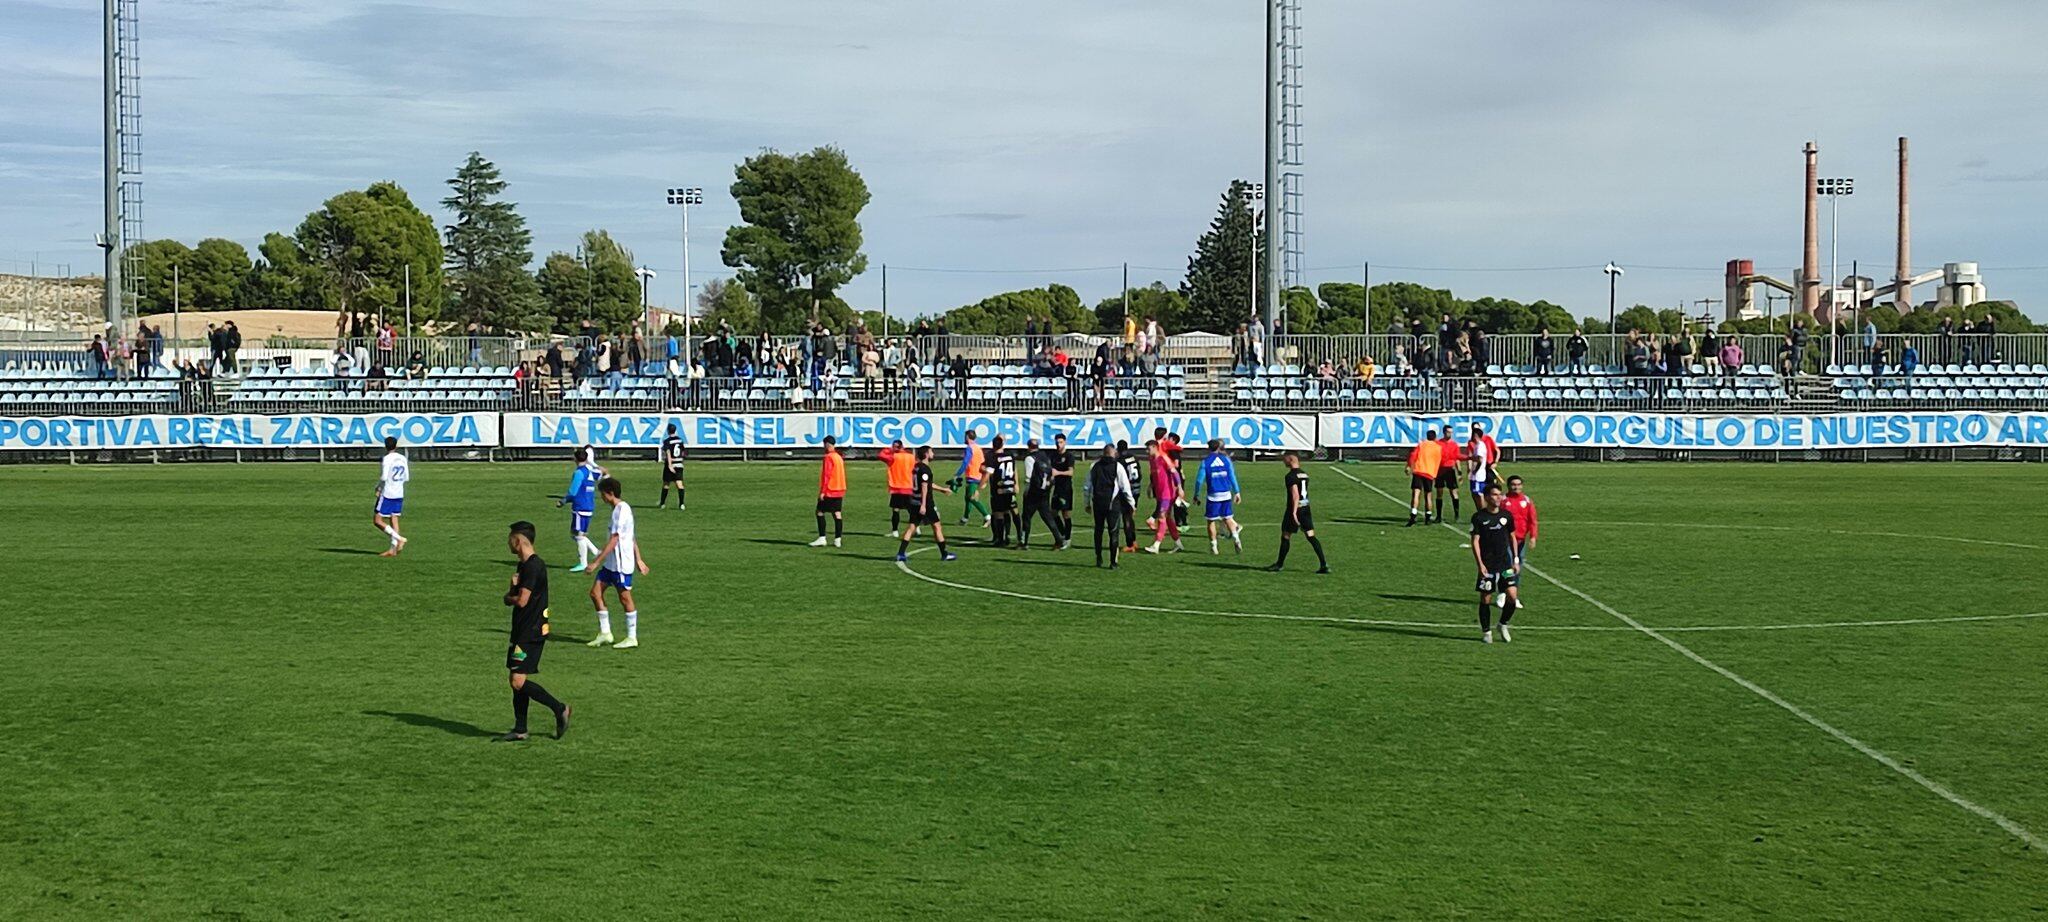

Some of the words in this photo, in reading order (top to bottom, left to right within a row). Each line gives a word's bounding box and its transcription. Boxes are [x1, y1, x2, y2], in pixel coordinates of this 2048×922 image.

[0, 418, 160, 446] PORTIVA
[168, 417, 263, 445] REAL
[270, 416, 481, 445] ZARAGOZA
[532, 416, 579, 444] LA
[588, 416, 688, 445] RAZA
[697, 417, 744, 445] EN
[754, 417, 796, 445] EL
[804, 416, 933, 445] JUEGO
[942, 417, 1113, 446] NOBLEZA
[1120, 417, 1147, 445] Y
[1530, 415, 1558, 443] Y
[1564, 415, 1746, 446] ORGULLO
[1754, 417, 1803, 446] DE
[1811, 414, 1989, 445] NUESTRO
[1997, 415, 2048, 443] AR
[673, 443, 681, 458] 6
[391, 465, 405, 482] 22
[998, 461, 1014, 479] 14
